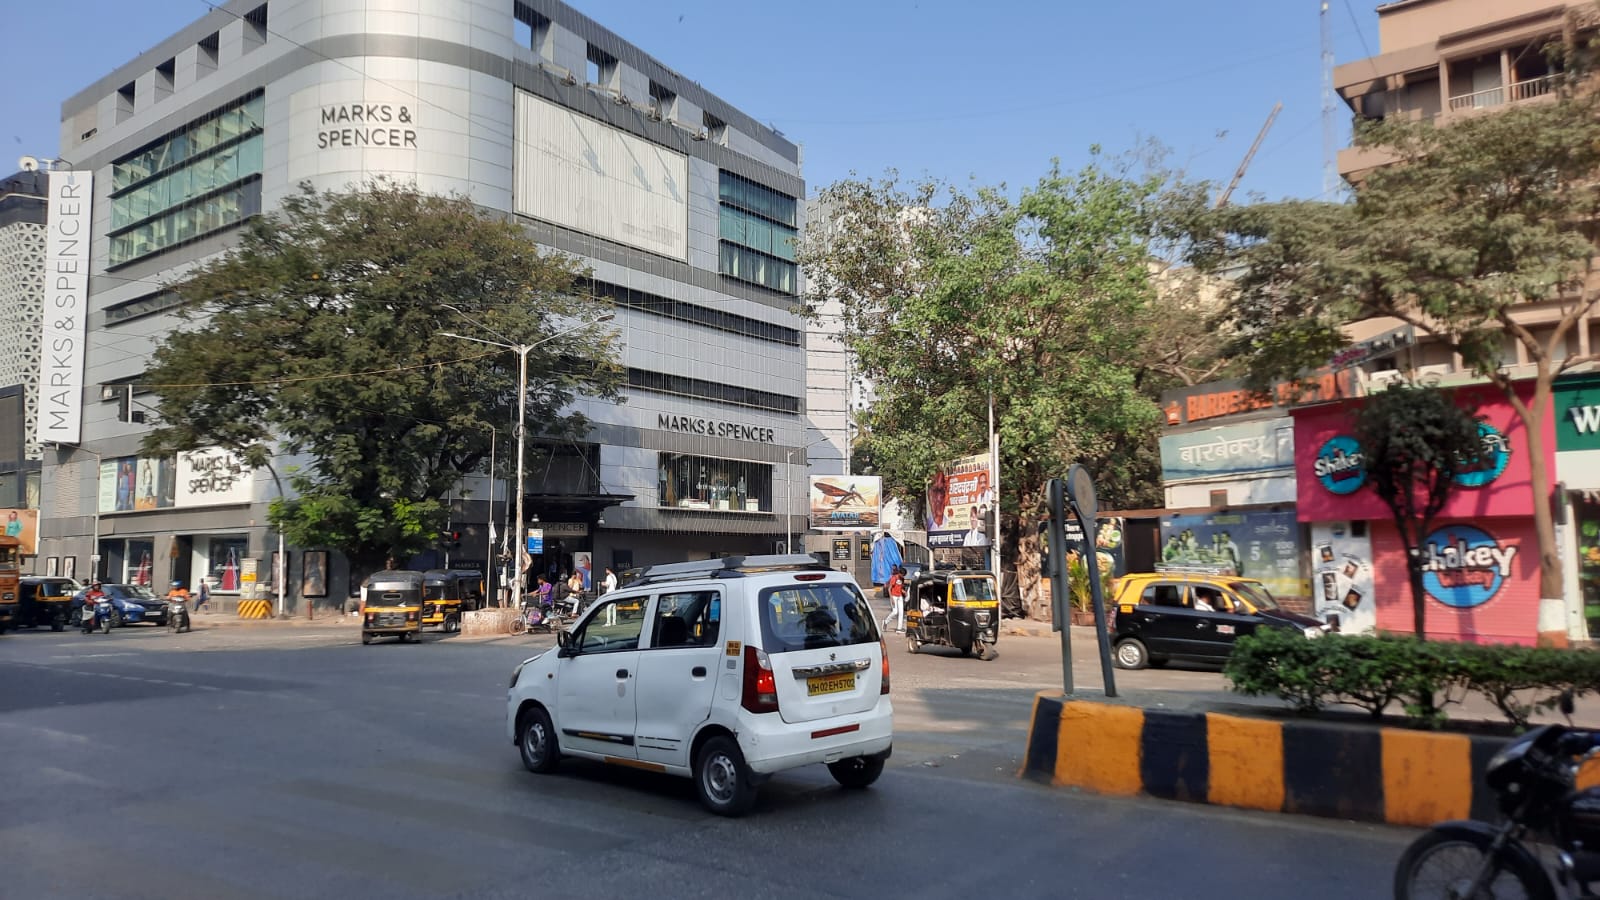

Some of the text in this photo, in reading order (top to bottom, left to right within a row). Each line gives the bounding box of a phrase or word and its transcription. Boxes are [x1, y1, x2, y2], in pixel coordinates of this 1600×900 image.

[321, 105, 412, 125] MARKS &
[318, 128, 418, 149] SPENCER
[49, 183, 81, 430] MARKS & SPENCER
[658, 413, 774, 442] MARKS & SPENCER
[1179, 434, 1275, 466] बारबेक्यू
